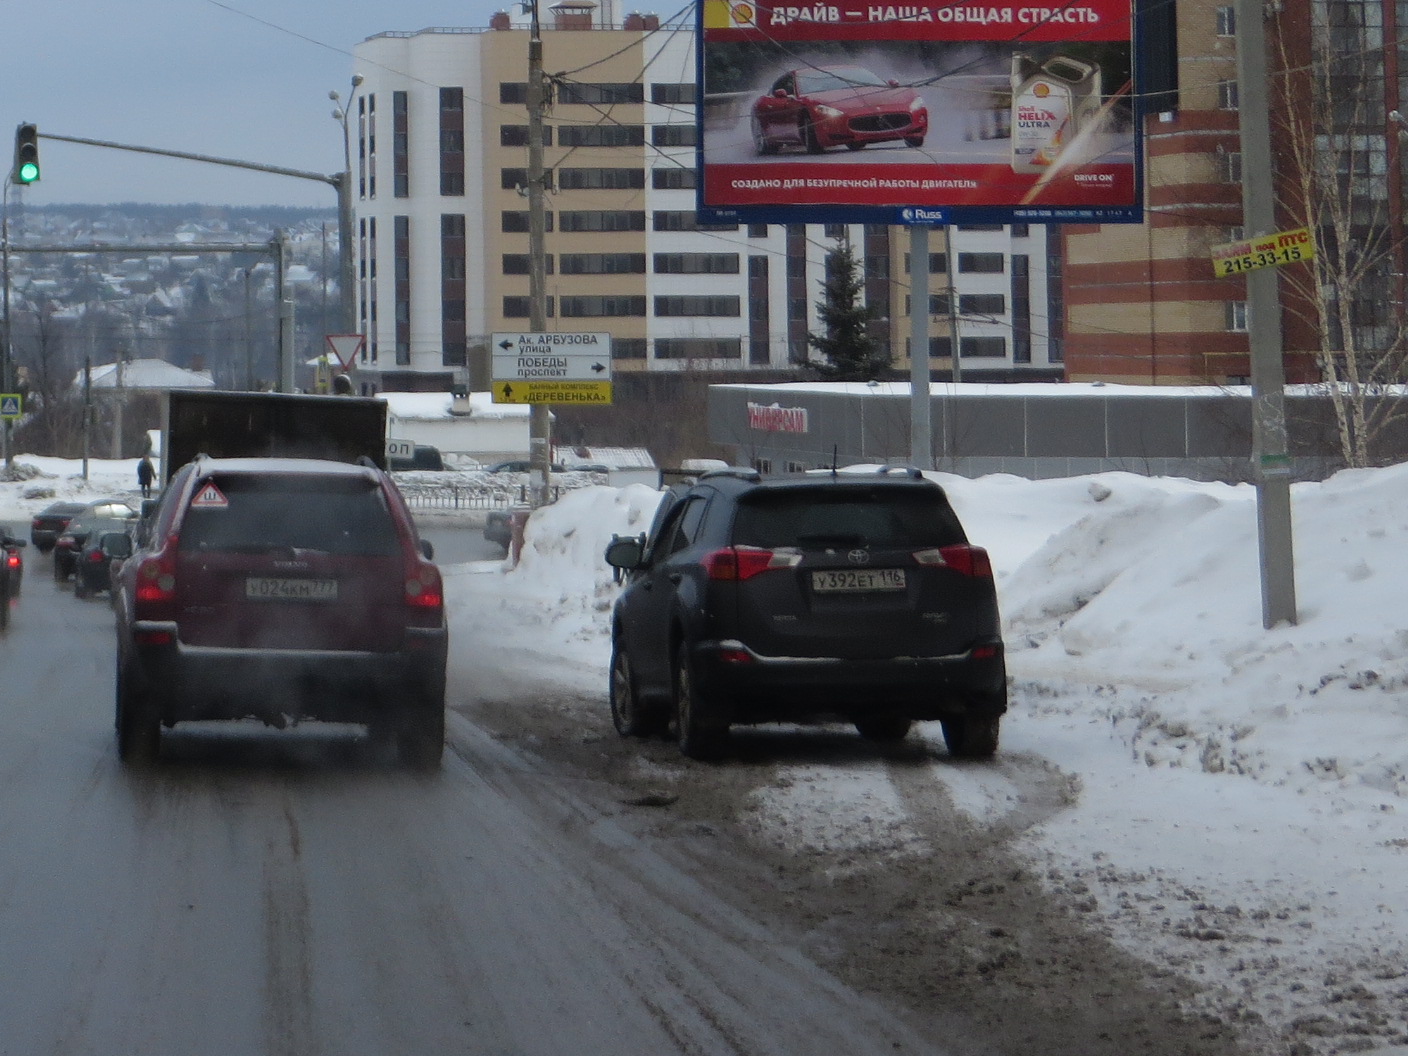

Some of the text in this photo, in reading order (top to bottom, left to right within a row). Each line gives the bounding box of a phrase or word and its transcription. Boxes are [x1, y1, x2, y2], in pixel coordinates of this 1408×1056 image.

[770, 2, 840, 26] ДРАЙВ
[868, 6, 933, 22] НАША
[937, 7, 1012, 25] ОБЩАЯ
[1017, 7, 1100, 23] СТРАСТЬ
[1018, 109, 1057, 121] HELIX
[731, 178, 977, 190] СОЗДАНО ДЛЯ БЕЗУПРЕЧНОЙ РАБОТЫ ДВИГАТЕЛЯ
[915, 209, 942, 219] Russ
[1277, 231, 1308, 248] ПТС
[1224, 247, 1301, 273] 215-33-15
[538, 335, 598, 345] АРБУЗОВА
[519, 345, 552, 355] улица
[517, 357, 568, 368] ПОБЕДЫ
[517, 369, 567, 378] проспект
[523, 392, 606, 403] «ДЕРЕВЕНЬКА»
